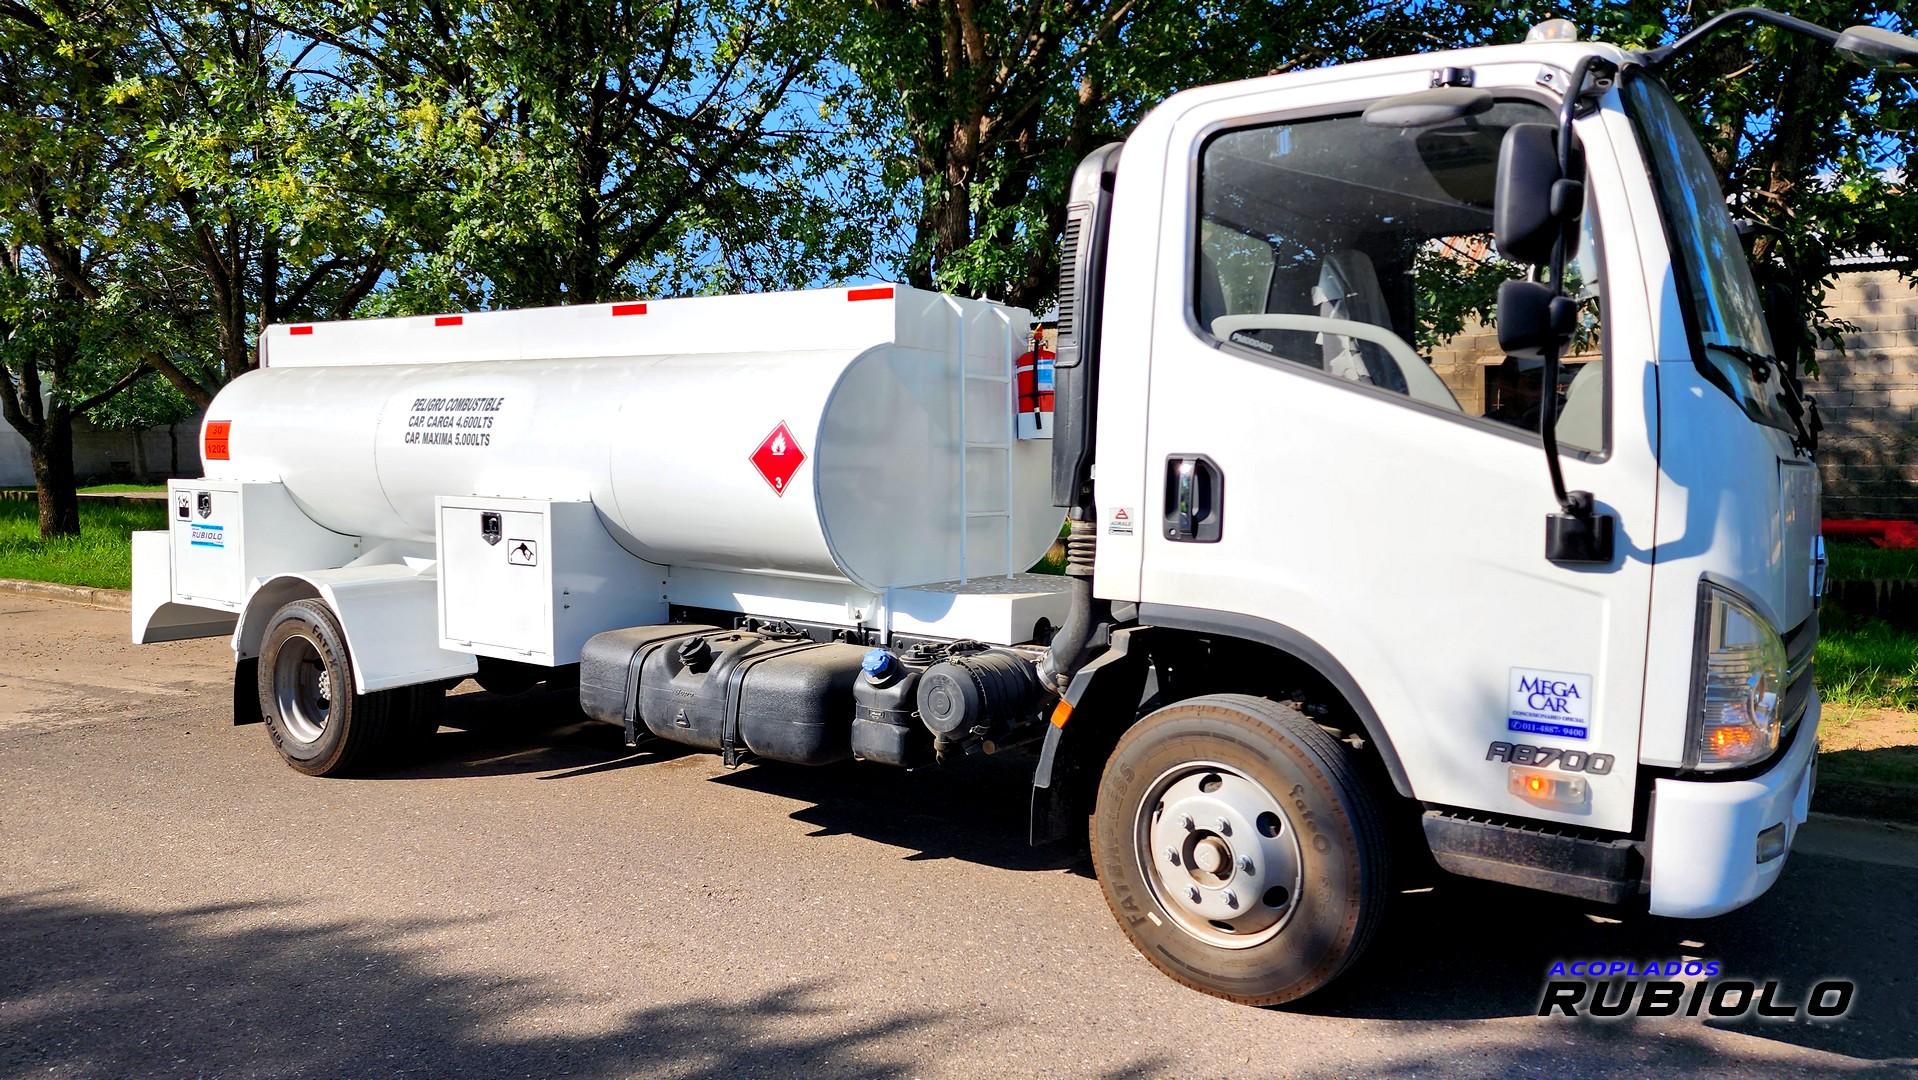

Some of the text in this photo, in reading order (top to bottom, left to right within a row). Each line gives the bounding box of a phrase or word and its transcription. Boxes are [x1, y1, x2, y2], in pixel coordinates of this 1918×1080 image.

[410, 397, 505, 412] PELIGRO COMBUSTIBLE
[408, 415, 494, 429] CAP. CARGA 4.600LTS
[212, 425, 223, 435] 30
[404, 431, 491, 447] CAP. MAXIMA 5.000LTS
[207, 444, 226, 454] 1202
[775, 476, 783, 489] 3
[192, 531, 223, 541] RUBIOLO
[1517, 675, 1581, 699] MEGA
[1527, 692, 1571, 714] CAR
[1562, 727, 1584, 737] 9400
[1485, 740, 1616, 776] A8700
